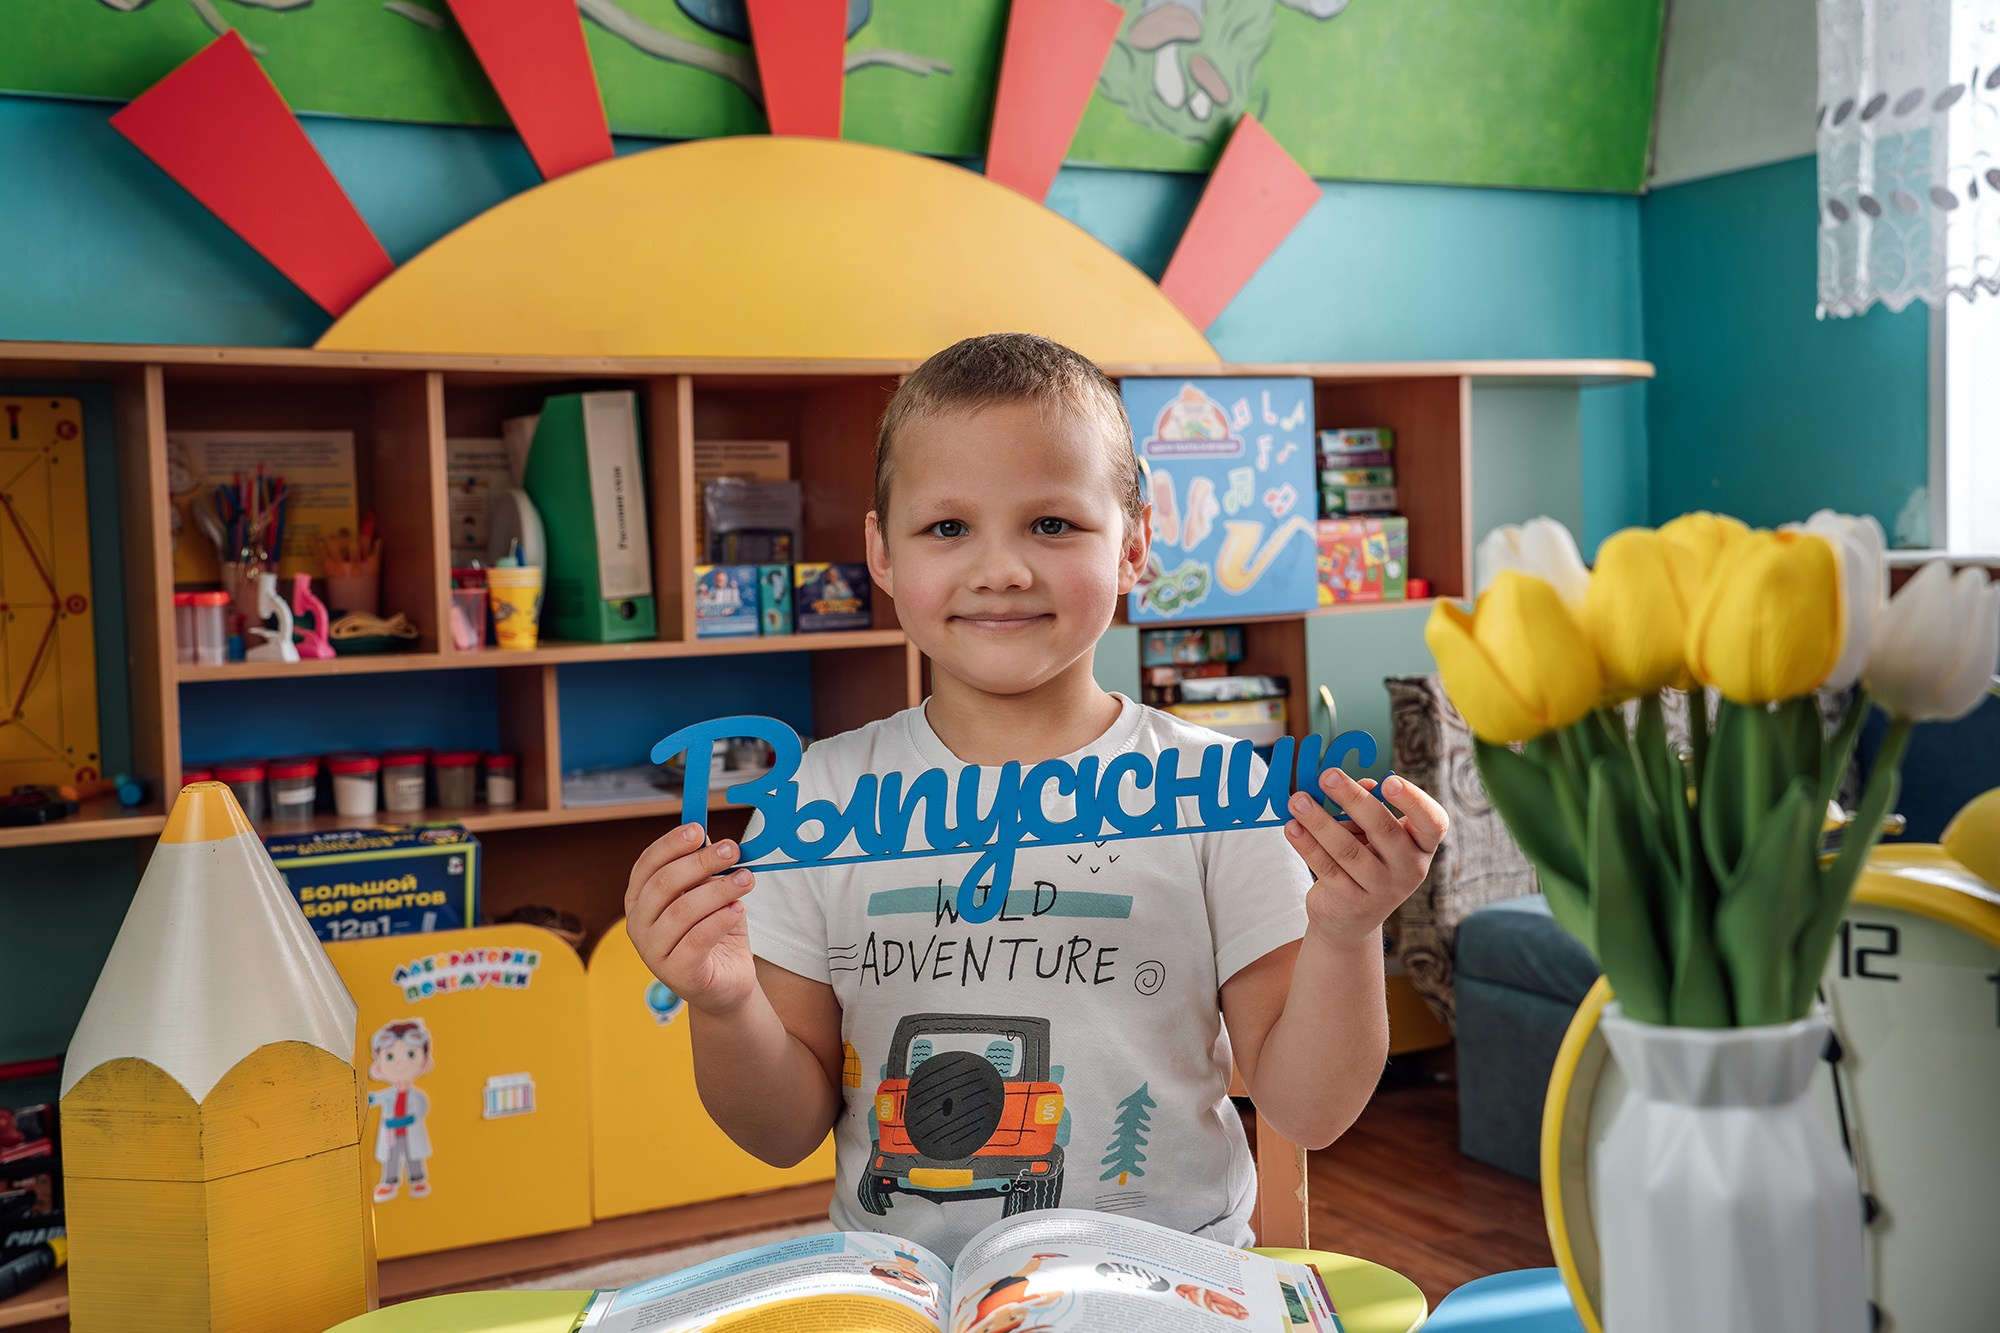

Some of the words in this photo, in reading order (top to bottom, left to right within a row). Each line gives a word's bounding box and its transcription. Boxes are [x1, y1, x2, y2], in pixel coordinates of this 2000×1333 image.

[301, 874, 417, 901] БОЛЬШОЙ
[303, 898, 348, 918] БОР
[352, 890, 447, 913] ОПЫТОВ
[860, 932, 1119, 987] ADVENTURE
[1840, 920, 1900, 982] 12
[394, 951, 538, 983] ЛАБОРАТОРИЯ
[406, 971, 528, 999] ПОЧЕМУЧКИ
